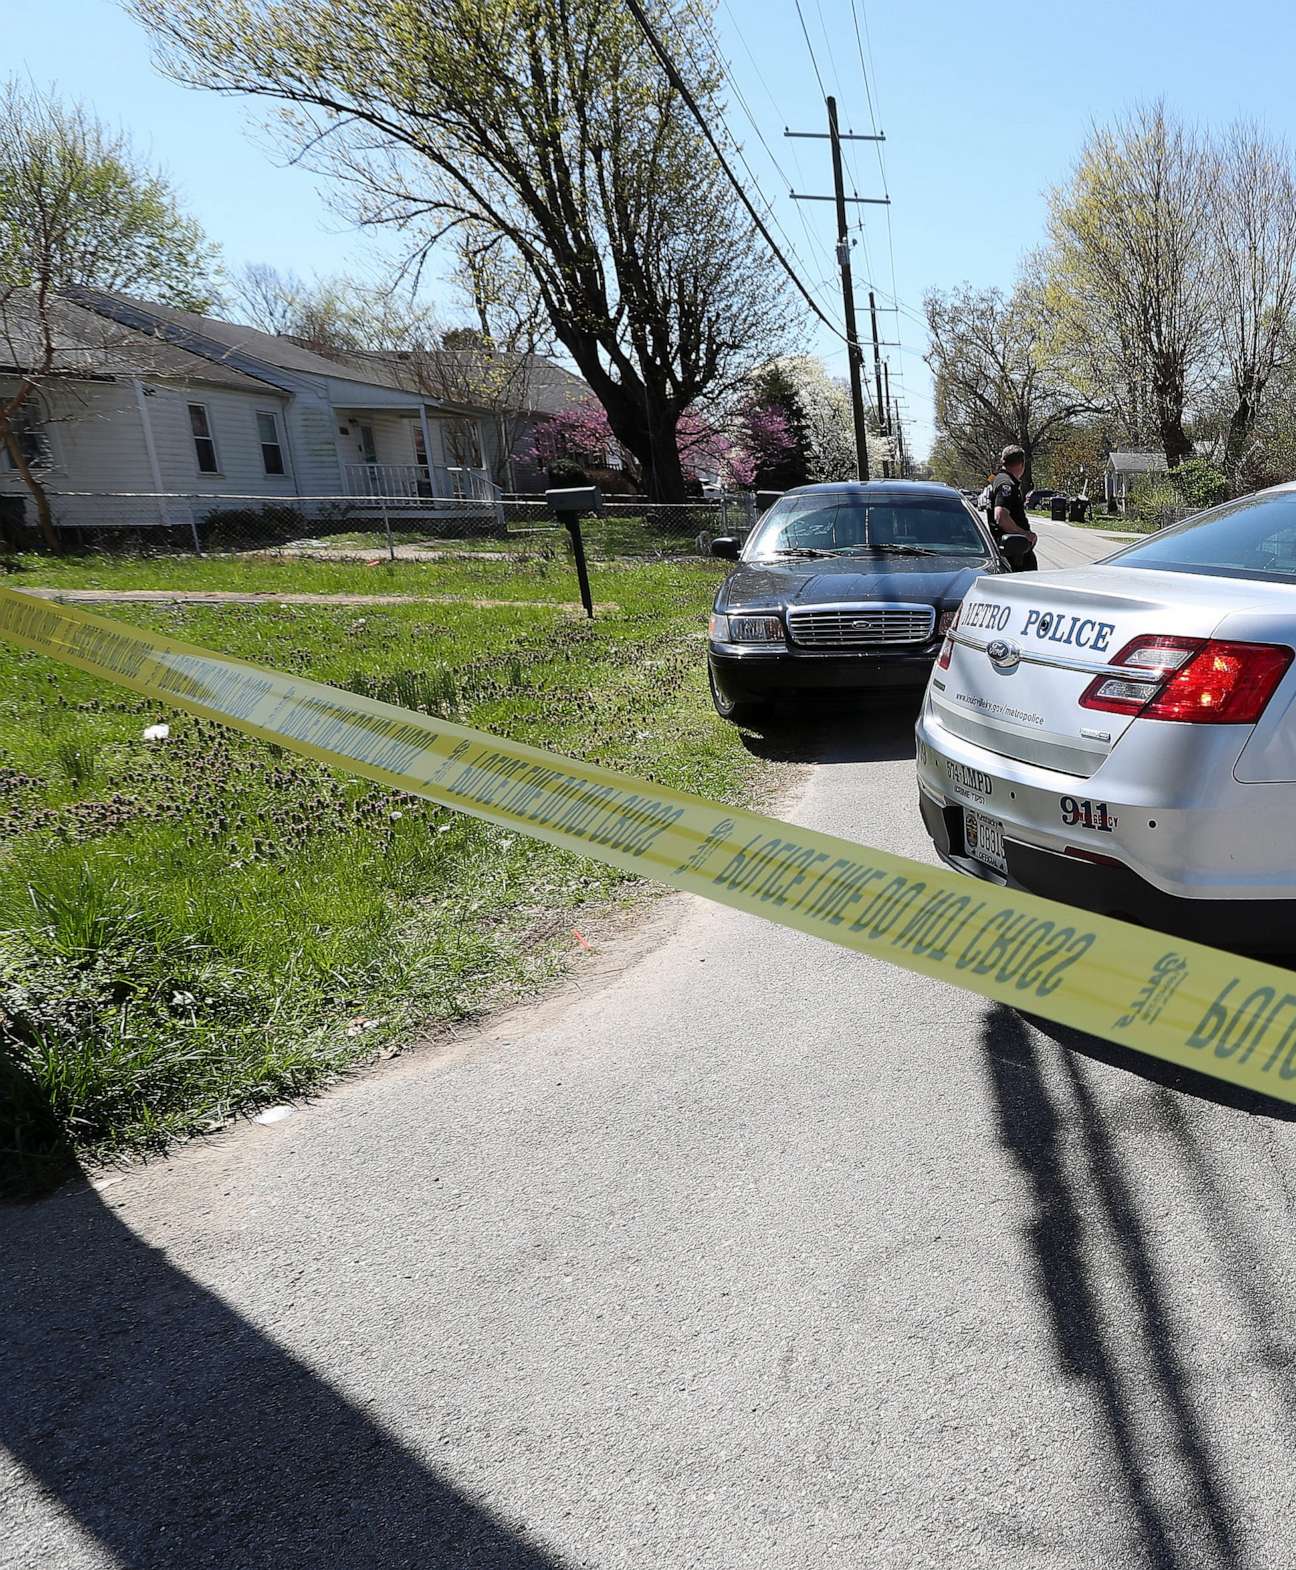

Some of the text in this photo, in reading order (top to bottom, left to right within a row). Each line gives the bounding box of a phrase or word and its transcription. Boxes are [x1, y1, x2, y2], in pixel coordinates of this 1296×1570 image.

[961, 602, 1116, 652] METRO POLICE
[1060, 795, 1112, 833] 911
